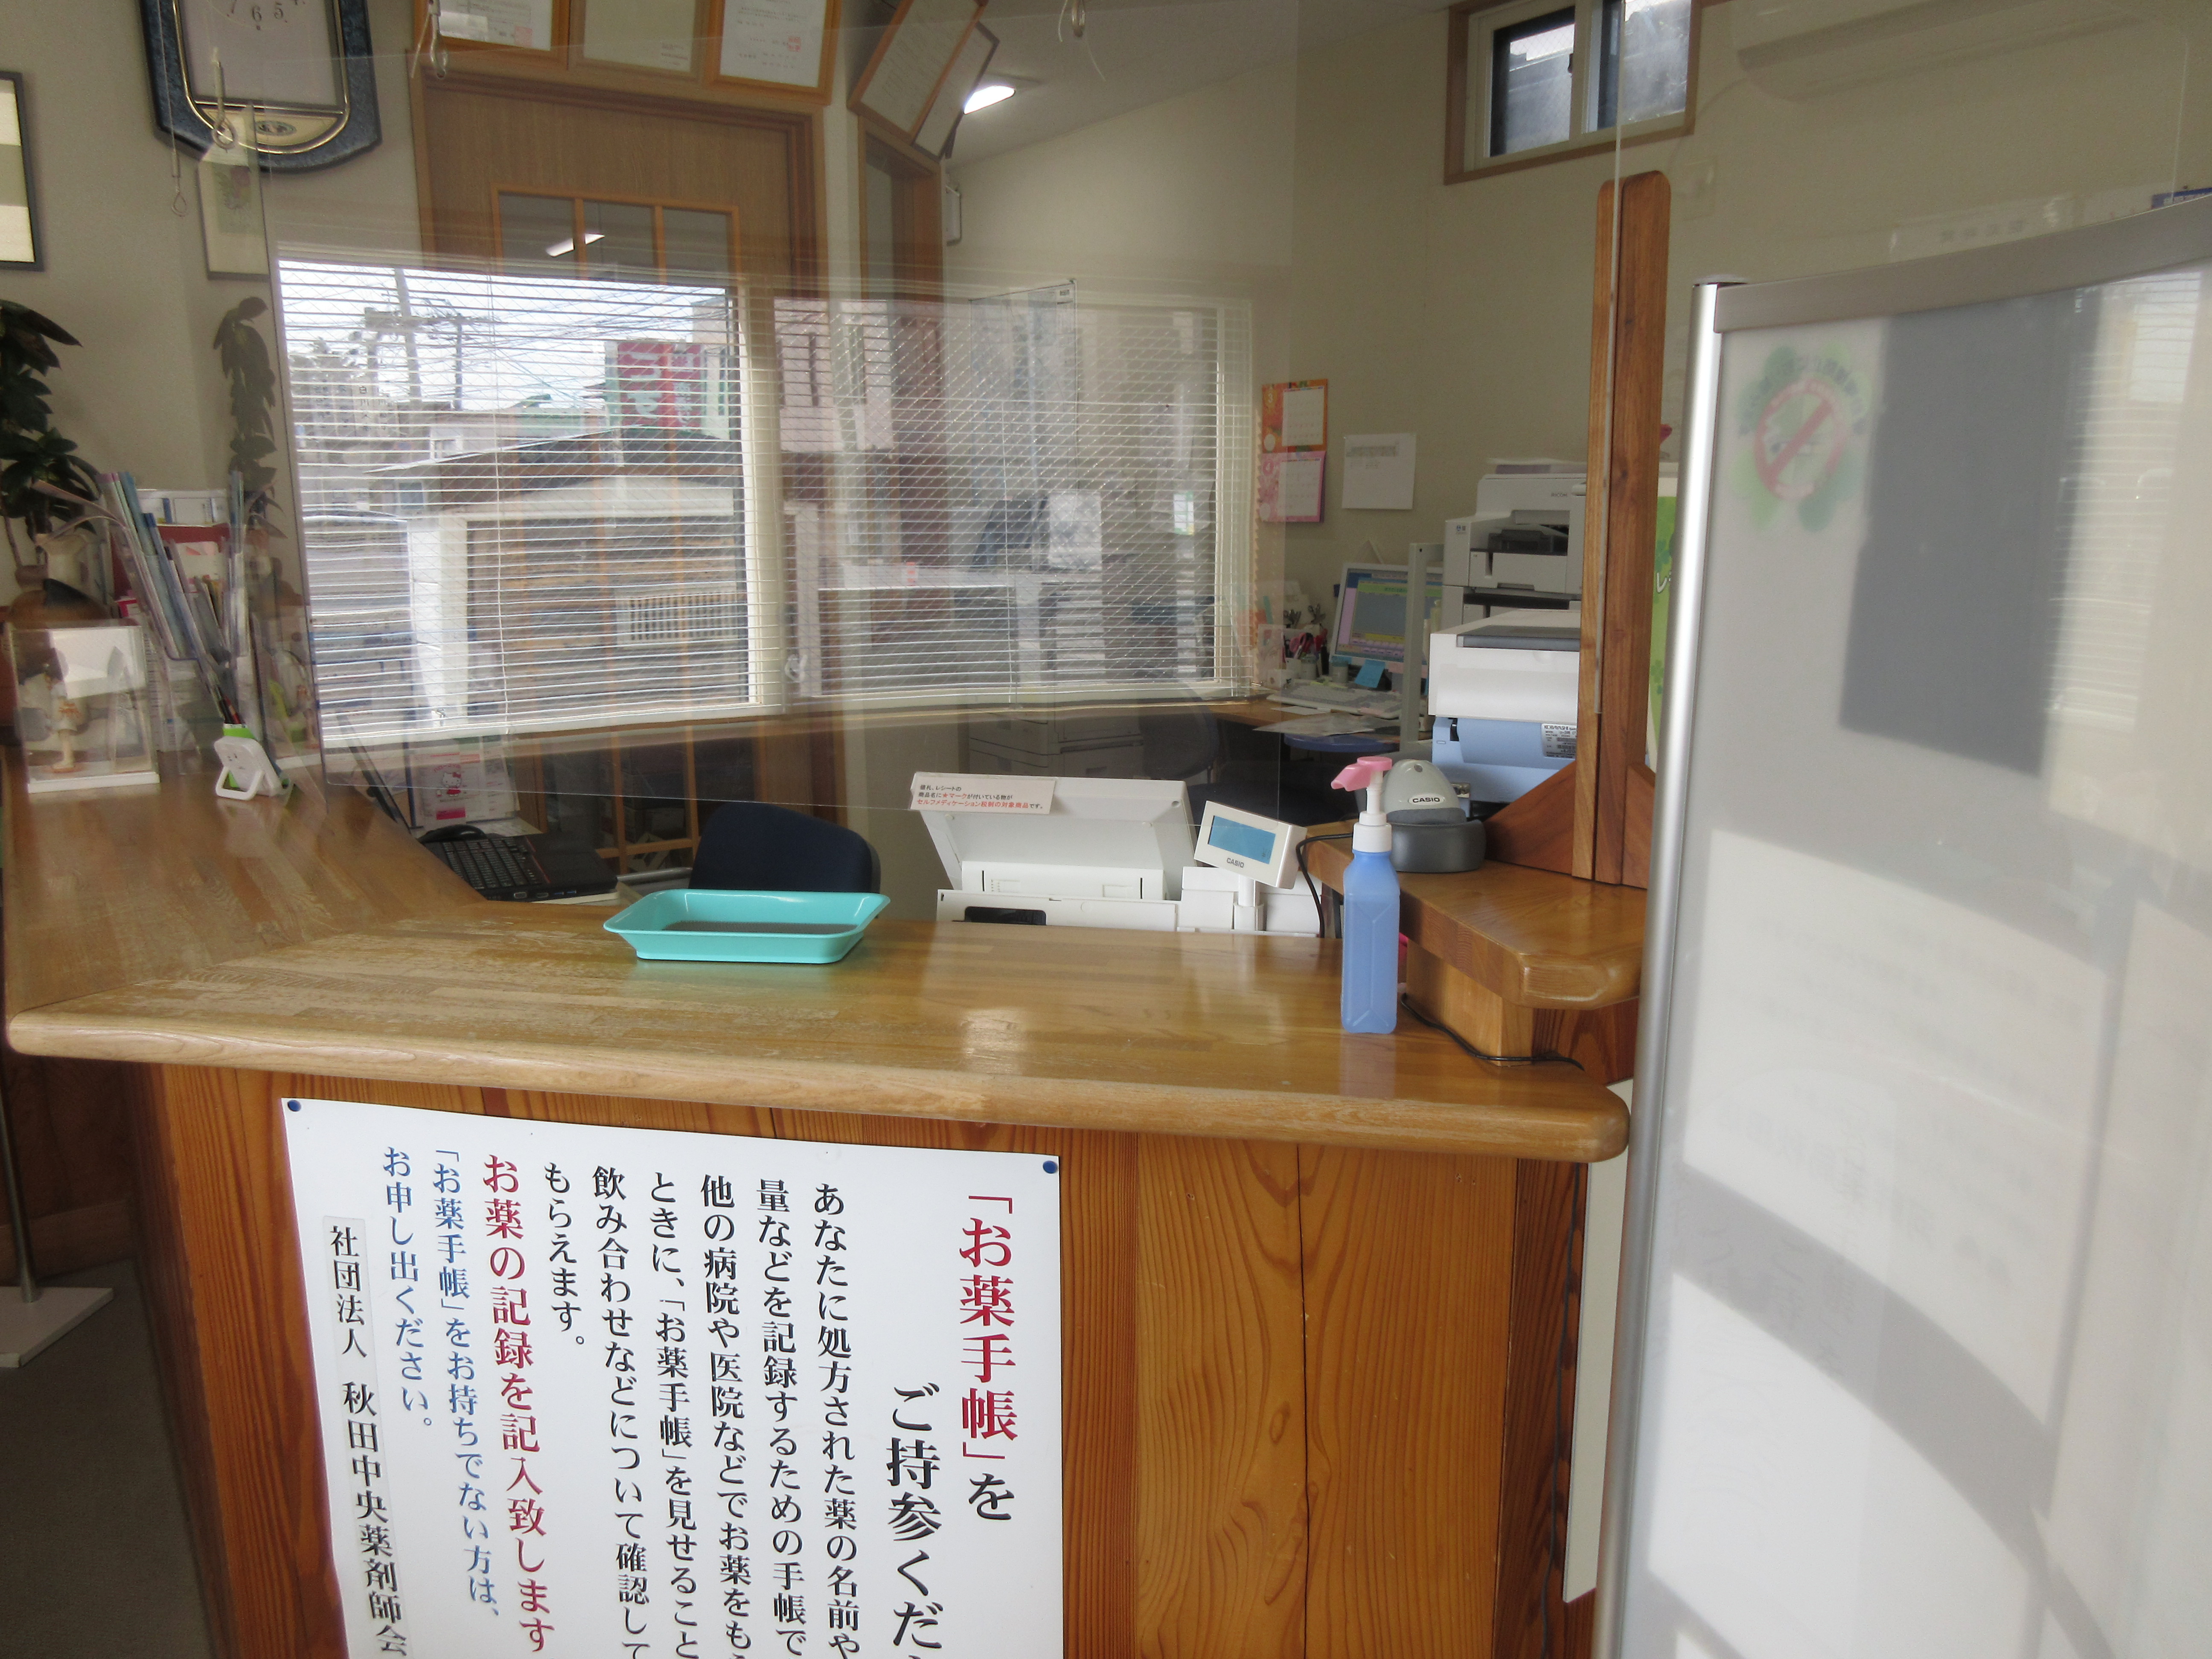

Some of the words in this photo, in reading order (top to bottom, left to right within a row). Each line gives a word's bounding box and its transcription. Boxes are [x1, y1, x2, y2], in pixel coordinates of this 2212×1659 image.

[251, 6, 262, 22] 6
[1226, 857, 1245, 868] CASIO
[329, 1225, 368, 1358] 社団法人
[383, 1147, 432, 1426] お申し出ください。
[433, 1149, 499, 1616] 「お薬手帳」をお持ちでない方は、
[544, 1162, 585, 1345] もらえます。
[959, 1195, 1018, 1521] 「お薬手帳」を
[341, 1381, 407, 1656] 秋田中央薬剤師会
[483, 1154, 555, 1653] お薬の記録を記入致します
[649, 1172, 699, 1659] ときに、「お薬手帳」を見せること
[700, 1174, 751, 1659] 他の病院や医院などでお薬をも
[814, 1183, 860, 1659] あなたに処方された薬の名前や
[885, 1382, 943, 1659] ご持参くだ
